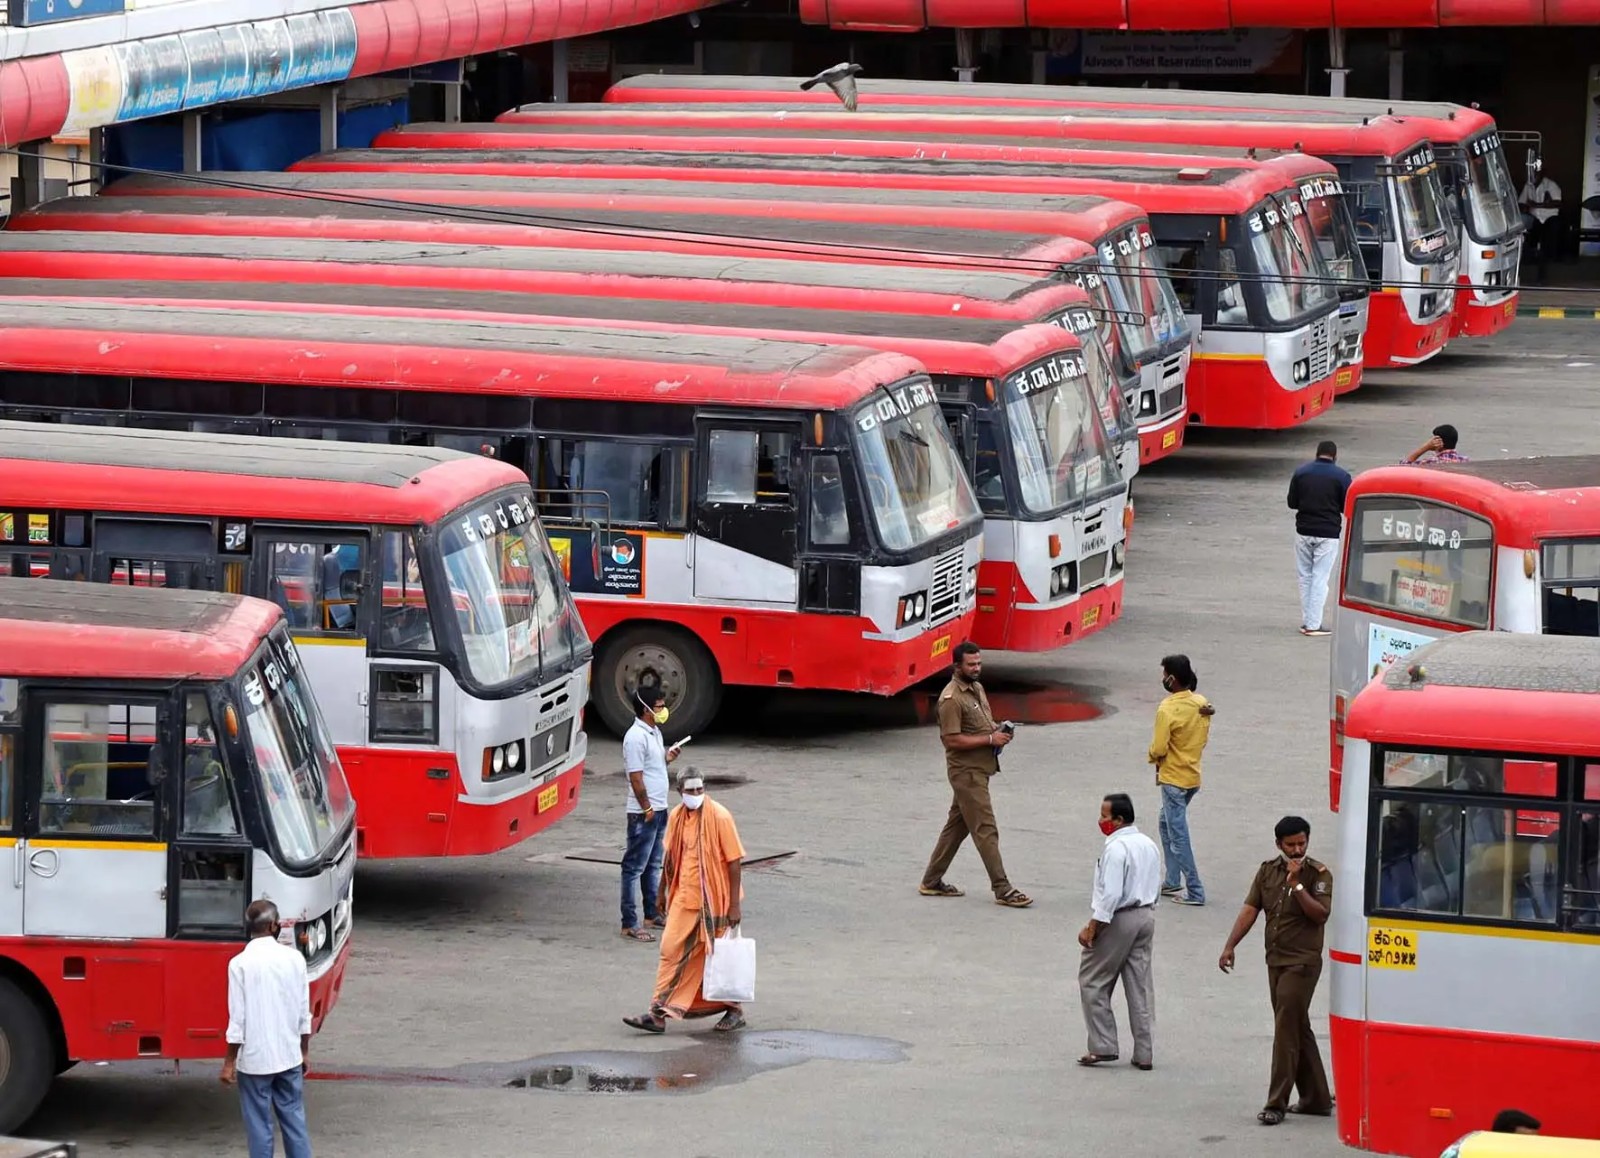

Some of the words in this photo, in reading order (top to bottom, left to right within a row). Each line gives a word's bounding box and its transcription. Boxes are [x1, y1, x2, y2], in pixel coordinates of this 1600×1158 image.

[1084, 55, 1124, 67] Advance
[1126, 55, 1155, 67] Ticket
[1158, 55, 1213, 67] Reservation
[1215, 56, 1252, 67] Counter
